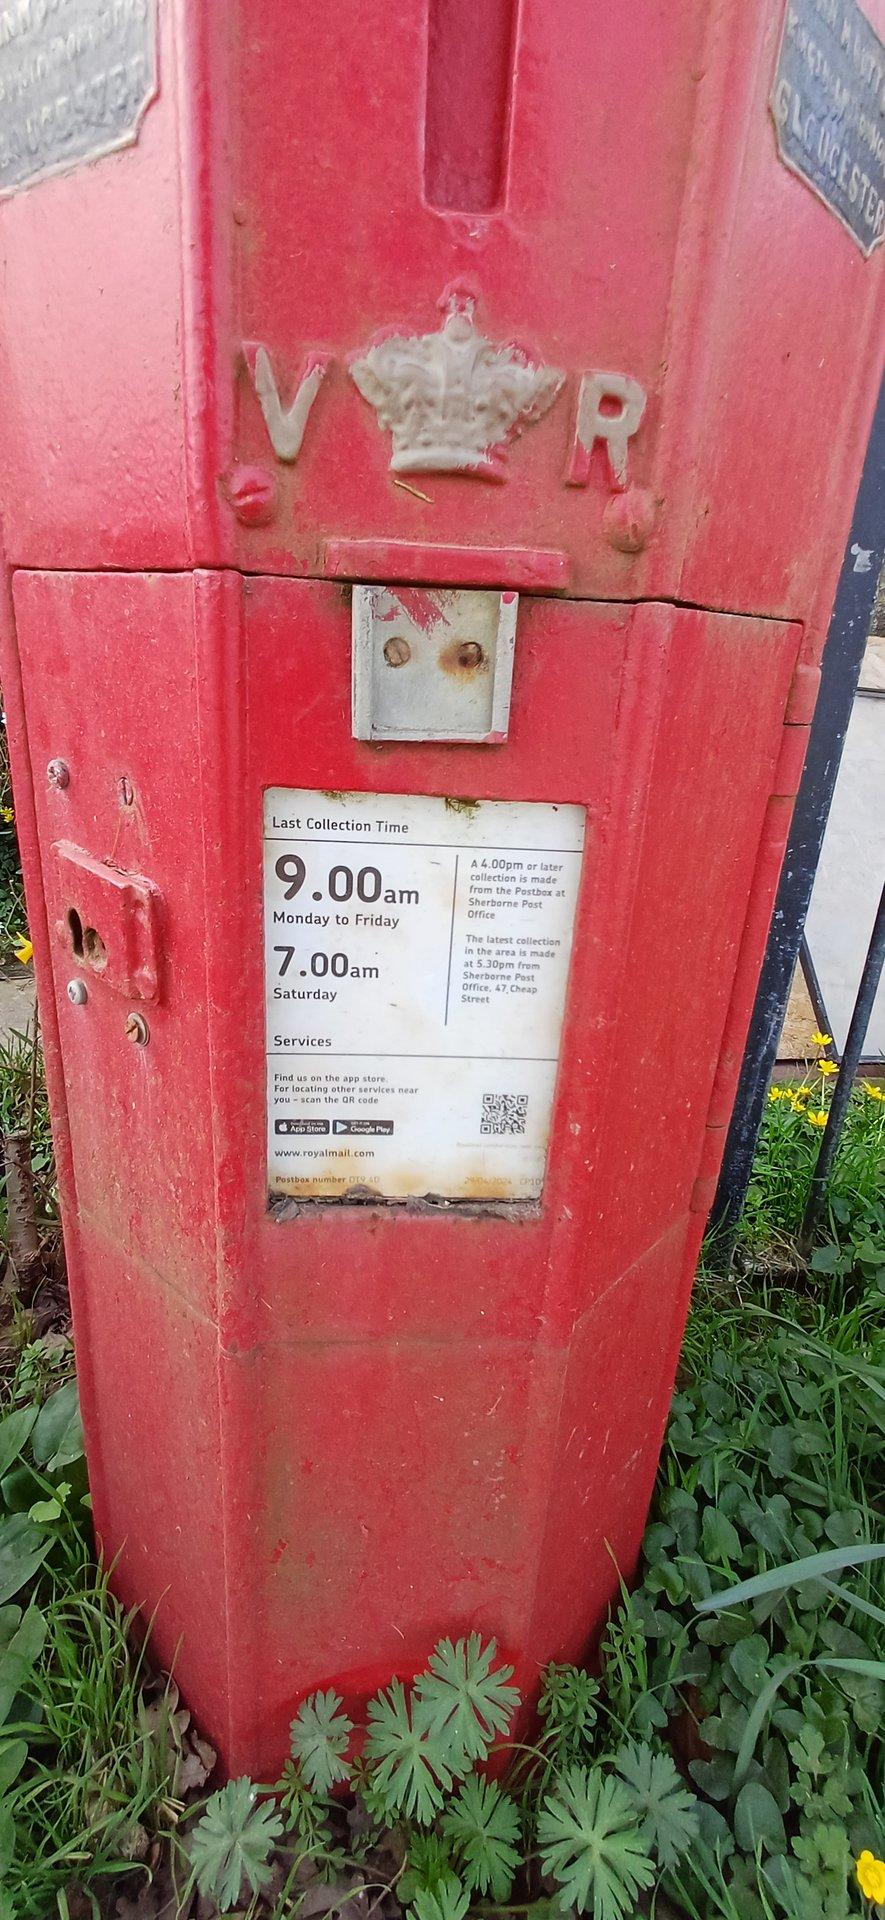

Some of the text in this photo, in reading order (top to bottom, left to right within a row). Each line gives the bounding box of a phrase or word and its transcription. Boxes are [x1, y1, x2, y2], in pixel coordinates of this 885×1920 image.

[241, 341, 648, 493] V R
[272, 817, 409, 833] Last Collection Time
[470, 860, 478, 868] A
[481, 859, 523, 871] 4.00pm
[541, 863, 564, 872] later
[275, 854, 419, 904] 9.00am
[470, 873, 557, 885] collection is made
[469, 885, 566, 898] from the Postbox at
[468, 898, 543, 909] Sherborne Post
[273, 911, 399, 929] Monday to Friday
[467, 910, 495, 920] Office
[466, 934, 561, 947] The latest collection
[464, 947, 556, 958] in the area is made
[273, 946, 379, 979] 7.00am
[463, 959, 541, 971] at 5.30pm from
[462, 971, 535, 982] Sherborne Post
[273, 988, 338, 1002] Saturday
[510, 985, 538, 995] Cheap
[461, 994, 490, 1004] Street
[273, 1035, 332, 1047] Services
[274, 1073, 294, 1082] Find
[325, 1074, 341, 1082] the
[343, 1076, 360, 1084] app
[274, 1085, 289, 1093] For
[292, 1085, 329, 1094] locating
[331, 1085, 356, 1094] other
[358, 1086, 395, 1094] services
[324, 1096, 339, 1104] the
[342, 1096, 355, 1104] QR
[290, 1126, 305, 1134] App
[350, 1126, 391, 1134] Google Play
[274, 1149, 375, 1159] www.royalmail.com
[275, 1176, 310, 1184] Postbox
[312, 1176, 346, 1184] number
